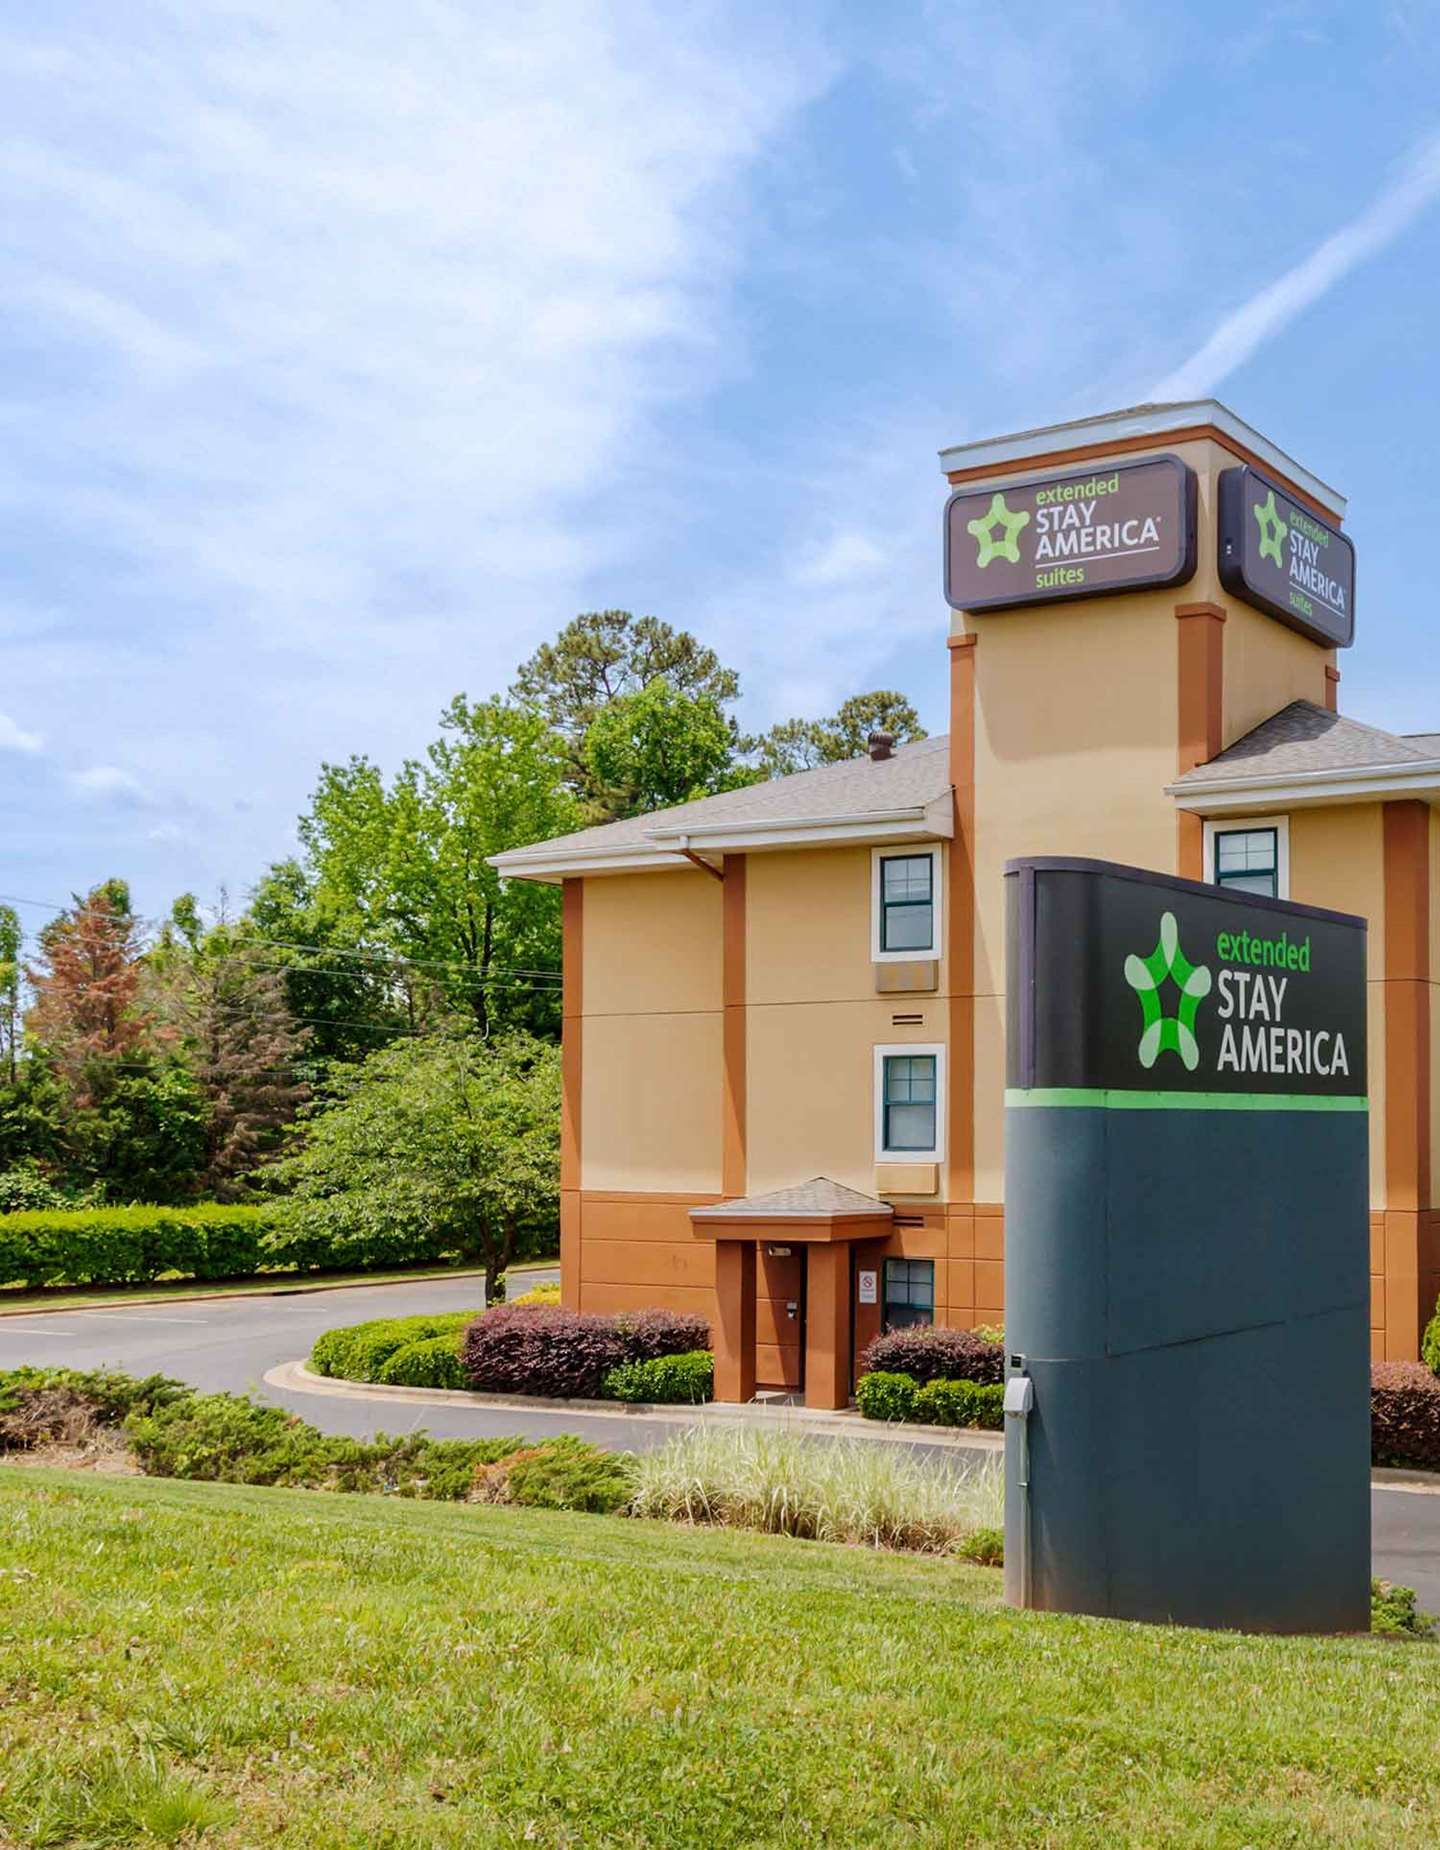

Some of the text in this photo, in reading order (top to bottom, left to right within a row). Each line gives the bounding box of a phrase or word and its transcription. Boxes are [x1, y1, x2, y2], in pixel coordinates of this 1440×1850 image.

[1036, 473, 1120, 506] extended
[1036, 501, 1097, 534] STAY
[1036, 519, 1160, 560] AMERICA
[1289, 528, 1319, 567] STAY
[1036, 567, 1085, 589] suites
[1289, 556, 1345, 610] AMERICA
[1216, 929, 1311, 973] extended
[1216, 969, 1288, 1022] STAY
[1216, 1023, 1350, 1076] AMERICA
